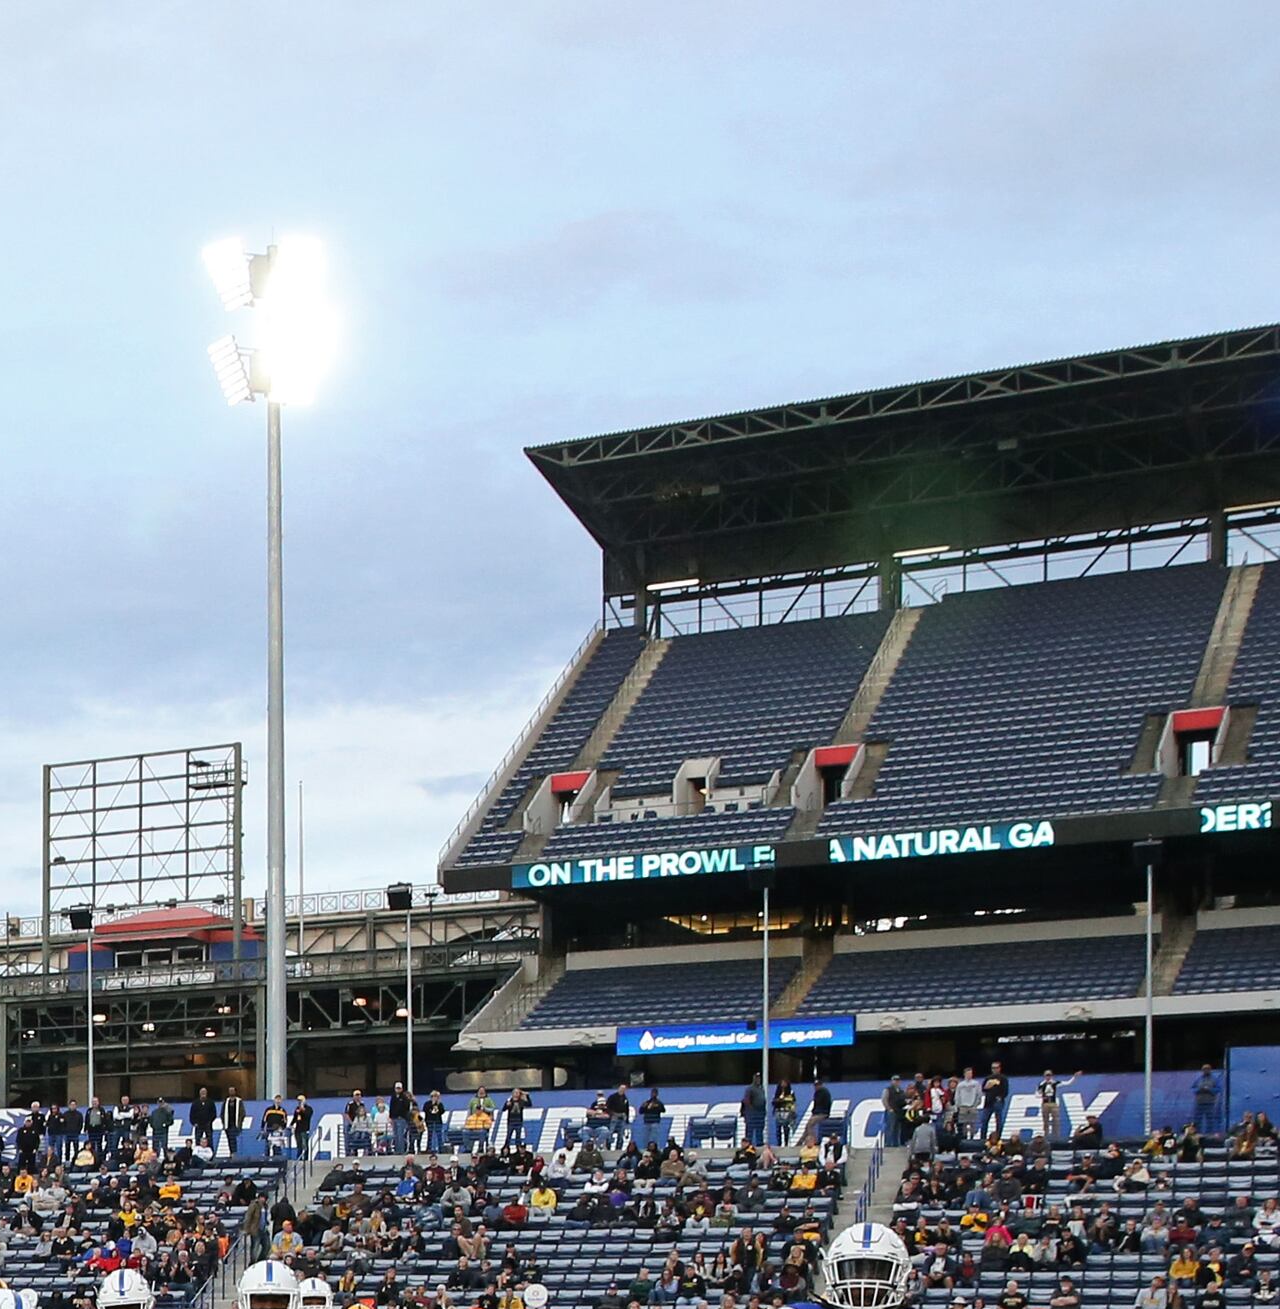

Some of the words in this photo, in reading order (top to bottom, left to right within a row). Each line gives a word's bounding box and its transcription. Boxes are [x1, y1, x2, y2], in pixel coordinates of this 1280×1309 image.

[528, 862, 571, 887] ON
[578, 857, 634, 883] THE
[641, 847, 746, 878] PROWL
[753, 844, 776, 868] F
[852, 825, 1002, 862] NATURAL
[655, 1035, 694, 1049] Georgia
[695, 1032, 739, 1046] Natural
